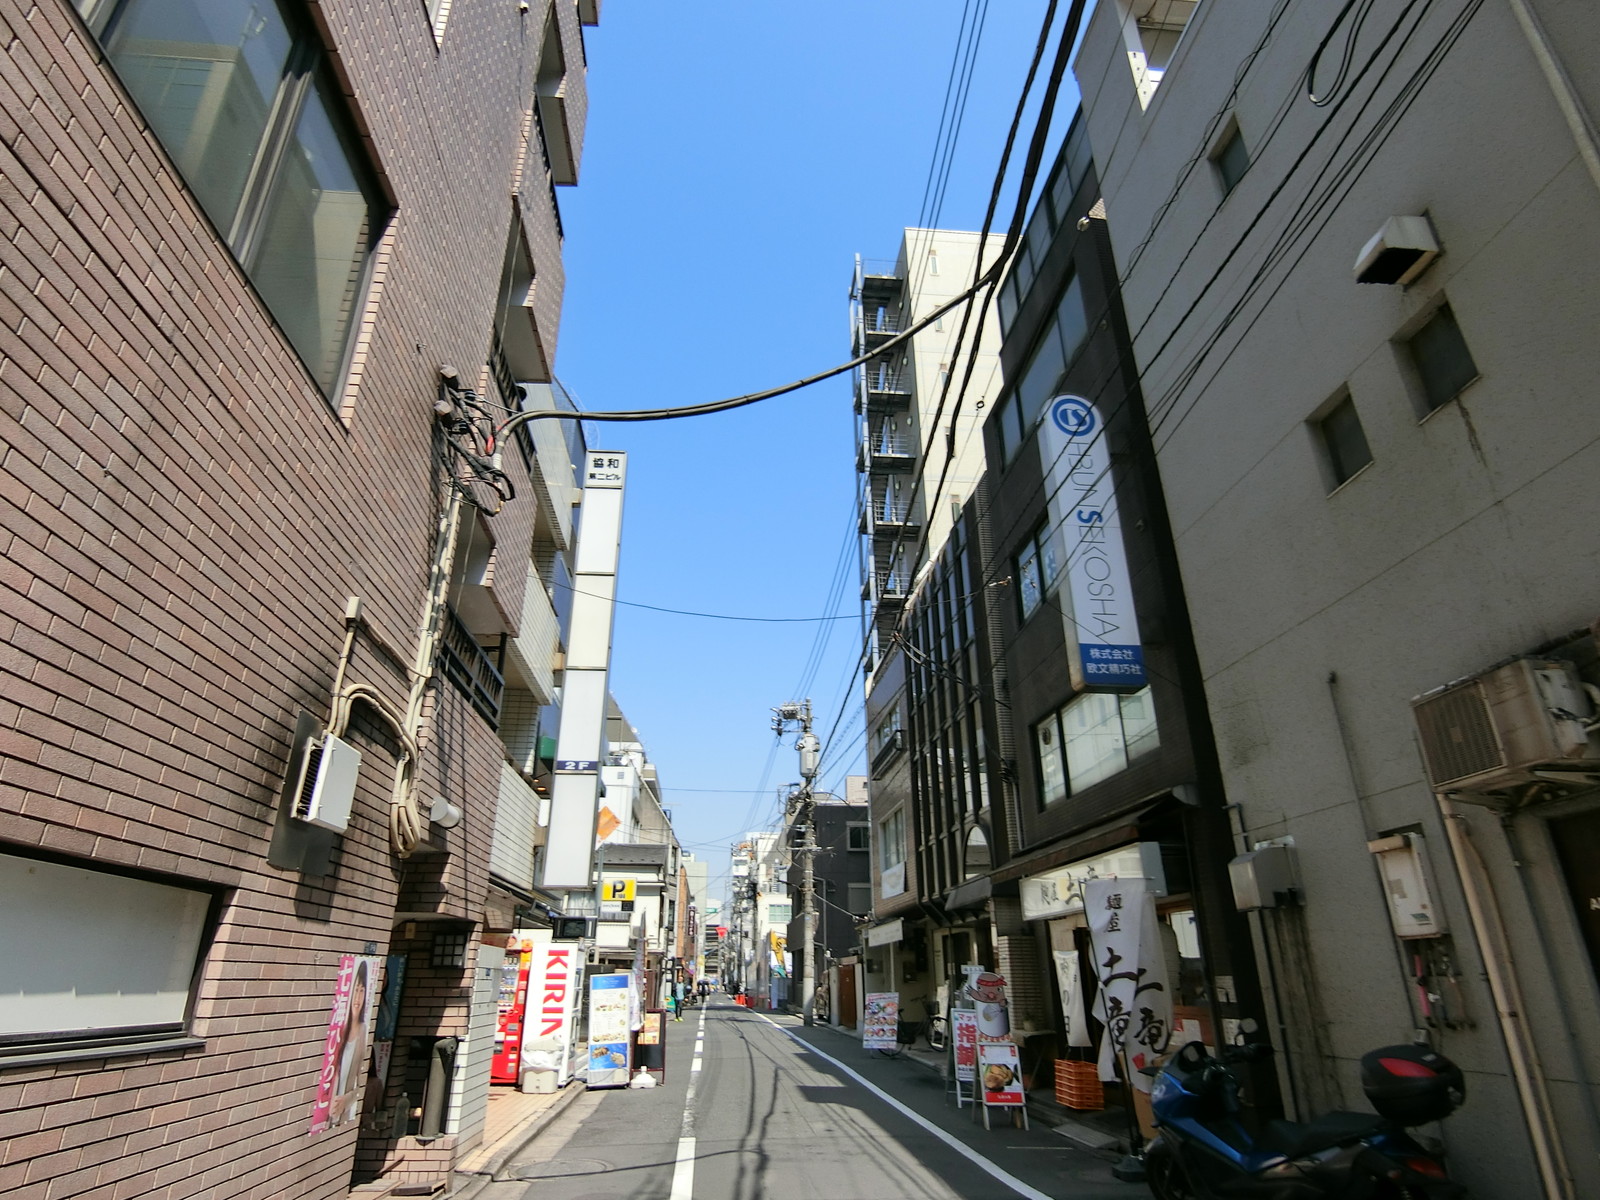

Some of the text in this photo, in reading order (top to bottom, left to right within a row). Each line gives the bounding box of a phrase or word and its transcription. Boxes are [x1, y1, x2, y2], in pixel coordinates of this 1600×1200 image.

[593, 458, 619, 468] 協和
[1089, 648, 1135, 660] 株式会社
[1086, 662, 1142, 675] 欧文精巧社
[564, 761, 590, 770] 2F
[612, 880, 625, 898] P
[317, 960, 352, 1108] 七海ひろこ
